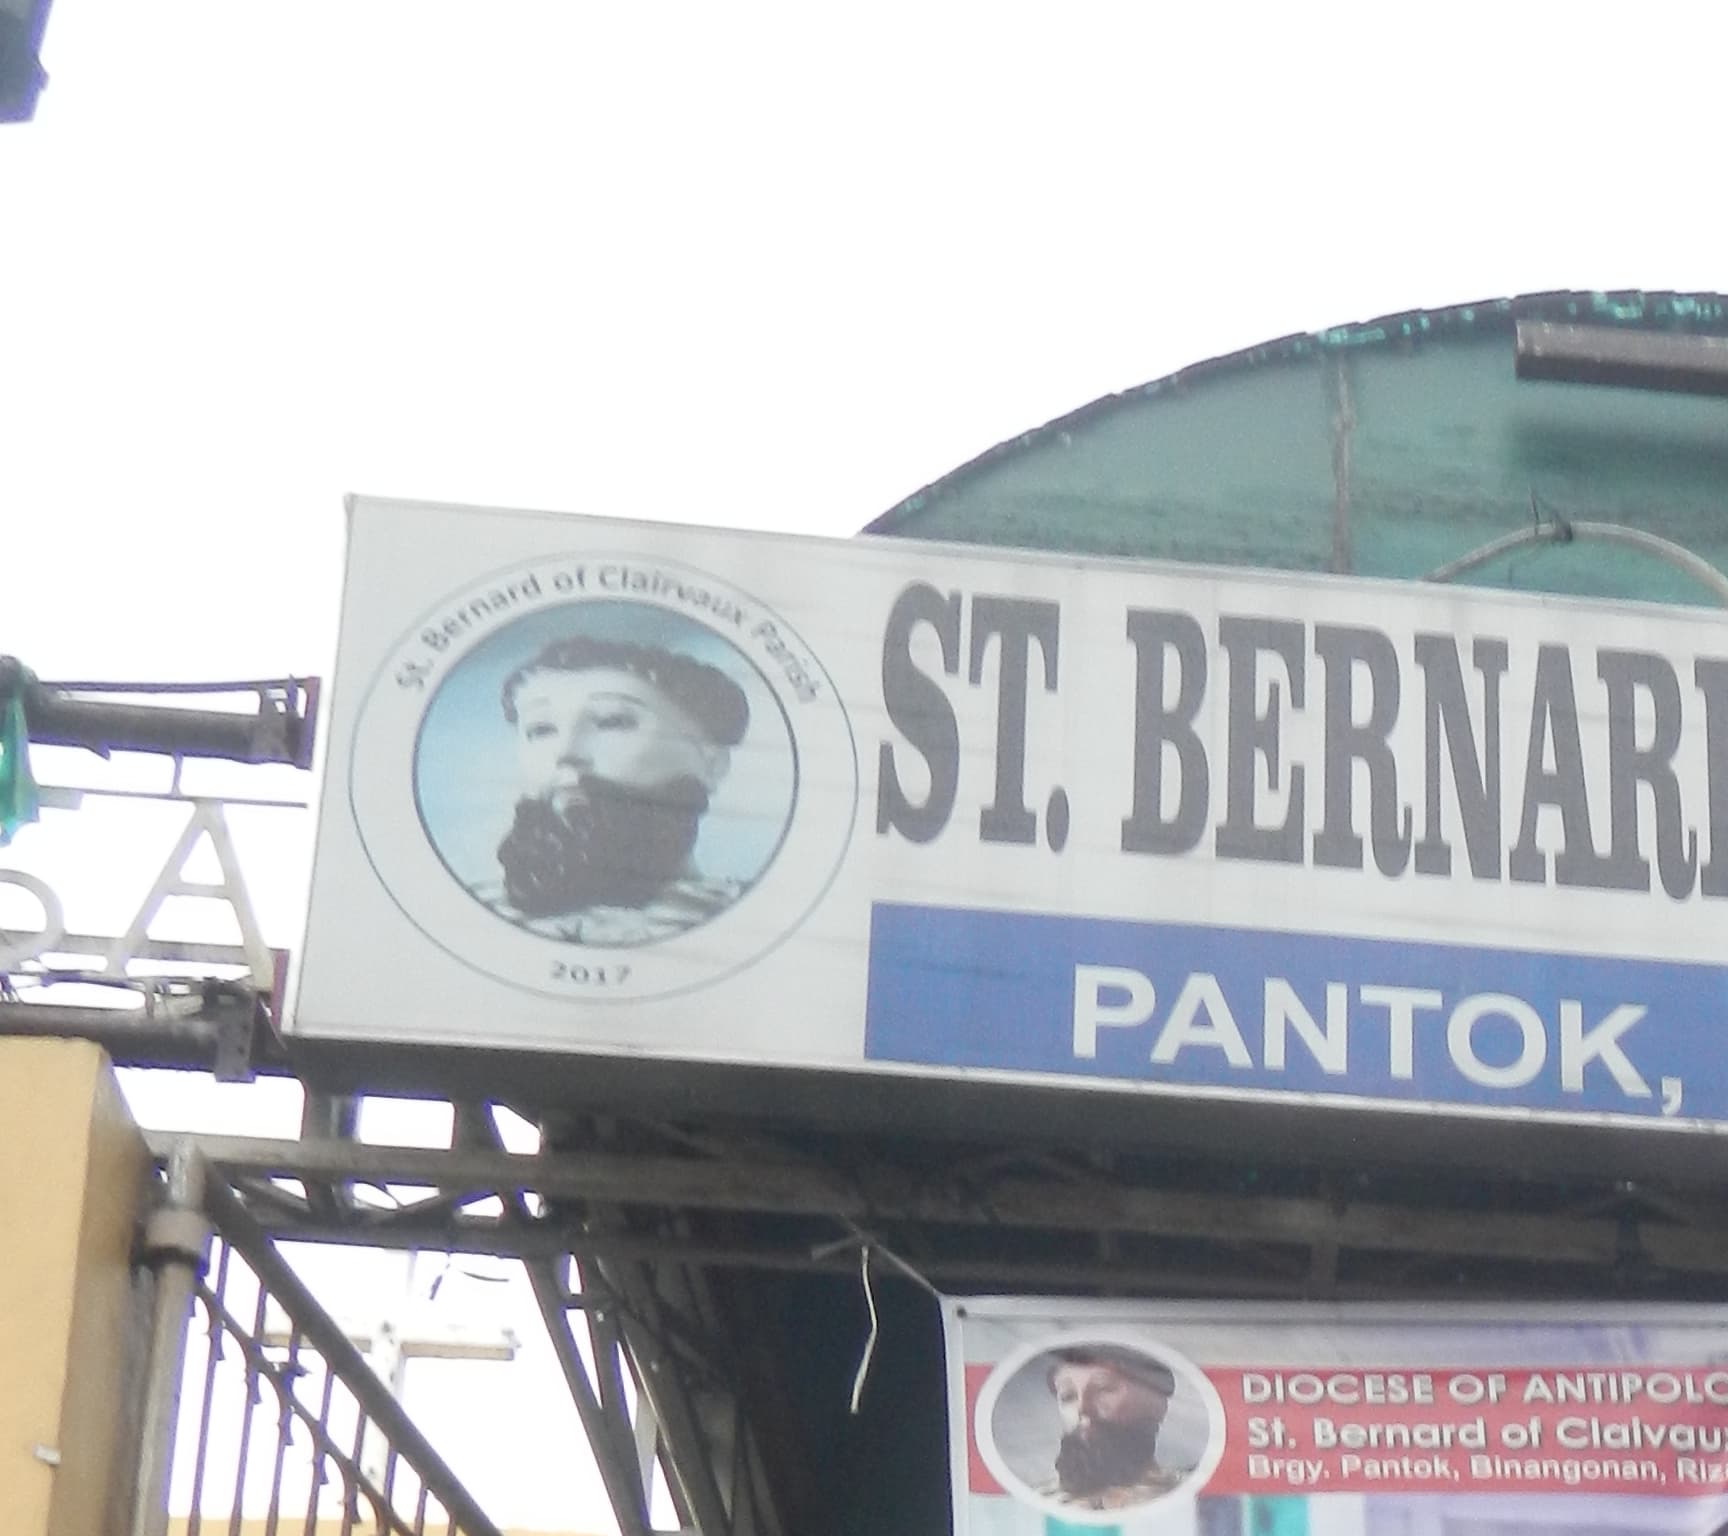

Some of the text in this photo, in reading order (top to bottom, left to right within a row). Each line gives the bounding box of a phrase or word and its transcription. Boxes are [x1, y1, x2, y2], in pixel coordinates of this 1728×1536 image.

[430, 573, 542, 657] Bernard
[554, 566, 586, 592] of
[599, 565, 749, 627] Clairvaux
[876, 580, 1070, 854] ST.
[549, 959, 632, 986] 2017
[1072, 964, 1683, 1116] PANTOK,
[1242, 1373, 1434, 1406] DIOCESE
[1448, 1373, 1506, 1405] OF
[1246, 1418, 1296, 1451] St.
[1313, 1416, 1487, 1450] Bernard
[1501, 1416, 1543, 1450] of
[1247, 1455, 1330, 1486] Brgy.
[1341, 1454, 1461, 1482] Pantok,
[1470, 1455, 1667, 1486] Binangonan,
